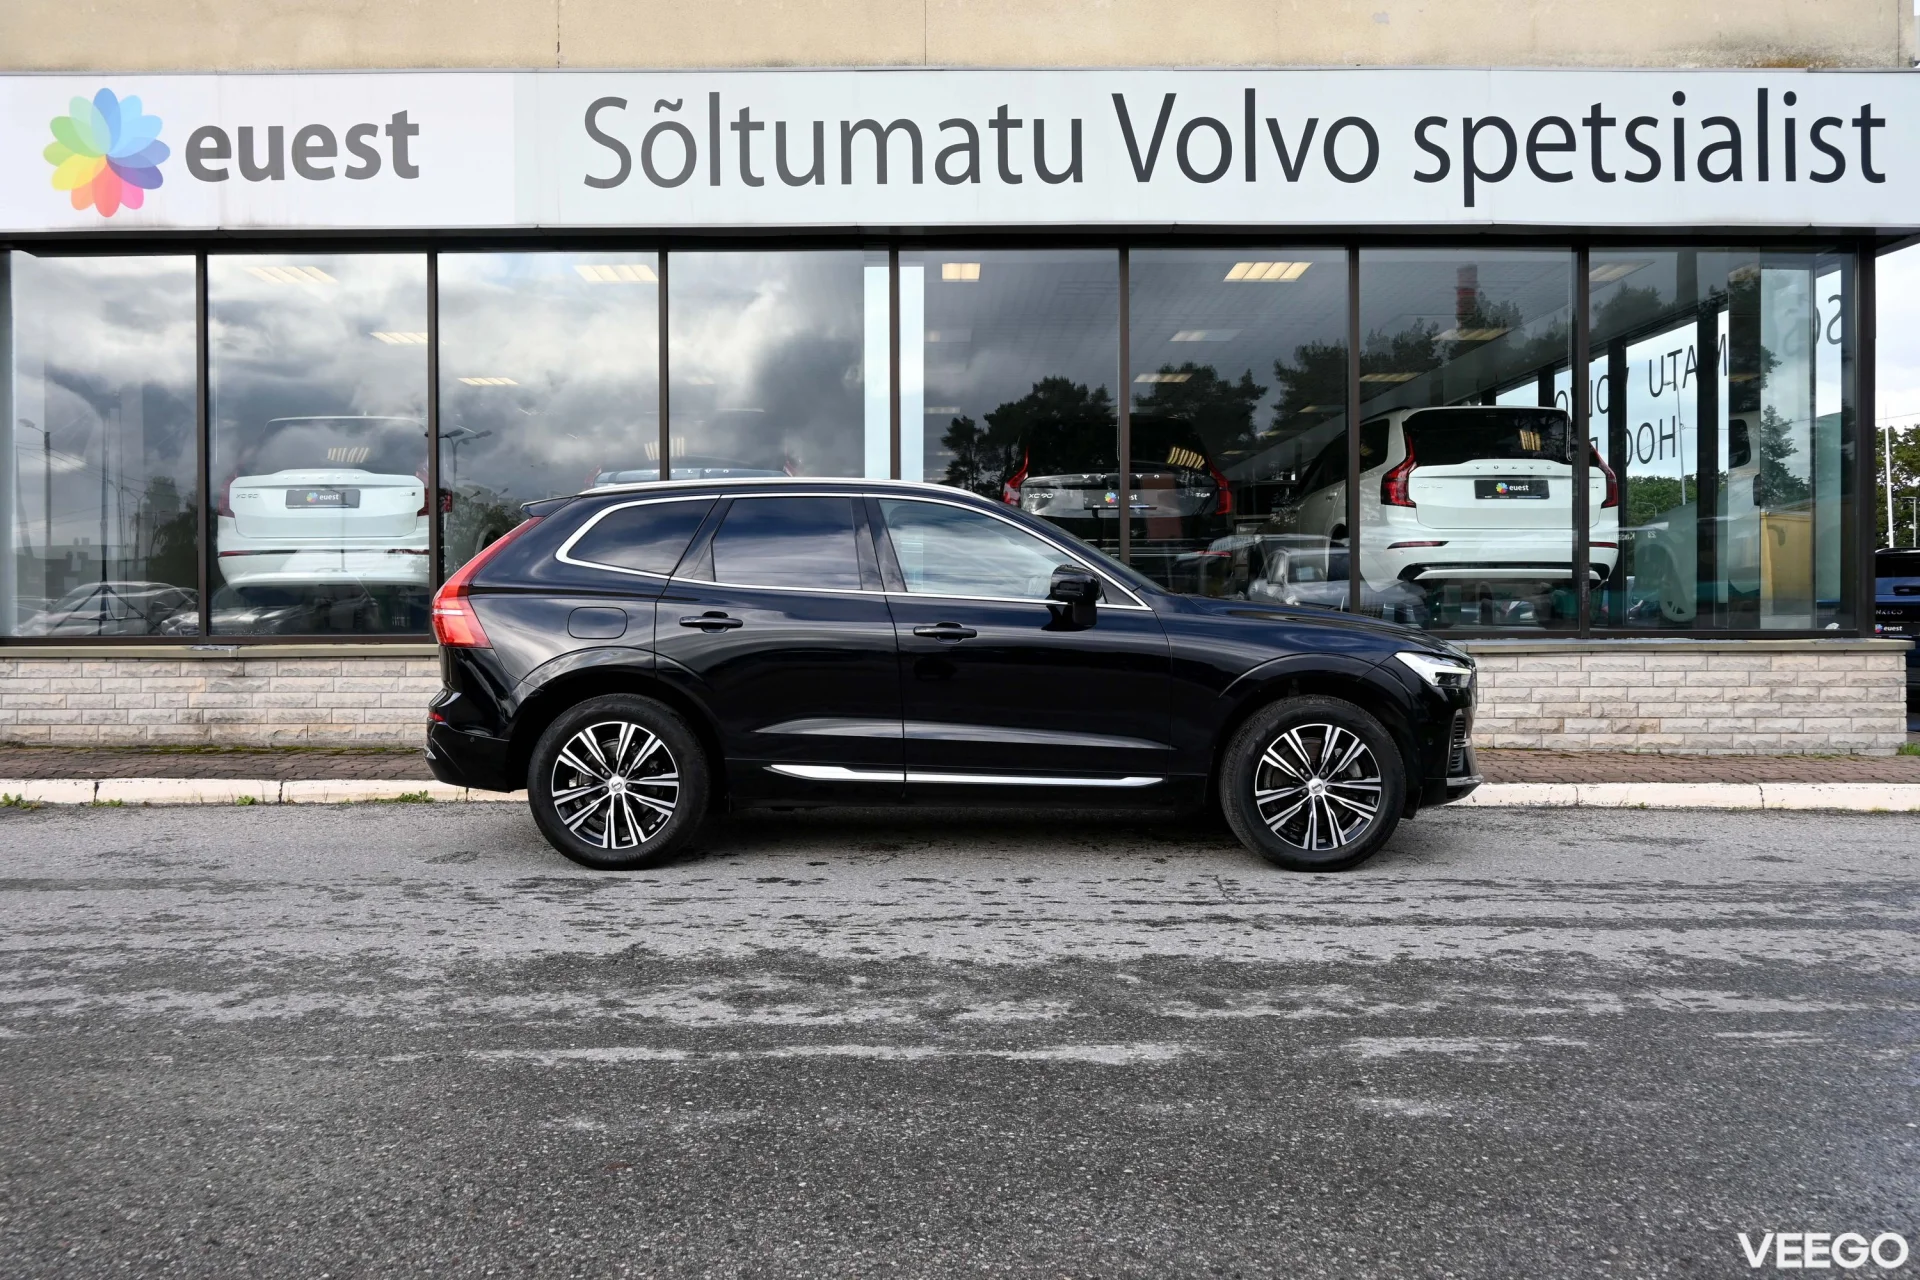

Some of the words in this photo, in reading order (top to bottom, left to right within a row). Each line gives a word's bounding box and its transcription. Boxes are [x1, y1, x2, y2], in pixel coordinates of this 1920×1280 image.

[185, 111, 419, 183] euest
[583, 91, 1083, 189] Sõltumatu
[1111, 87, 1380, 184] Volvo
[1413, 87, 1886, 208] spetsialist
[319, 493, 339, 501] euest
